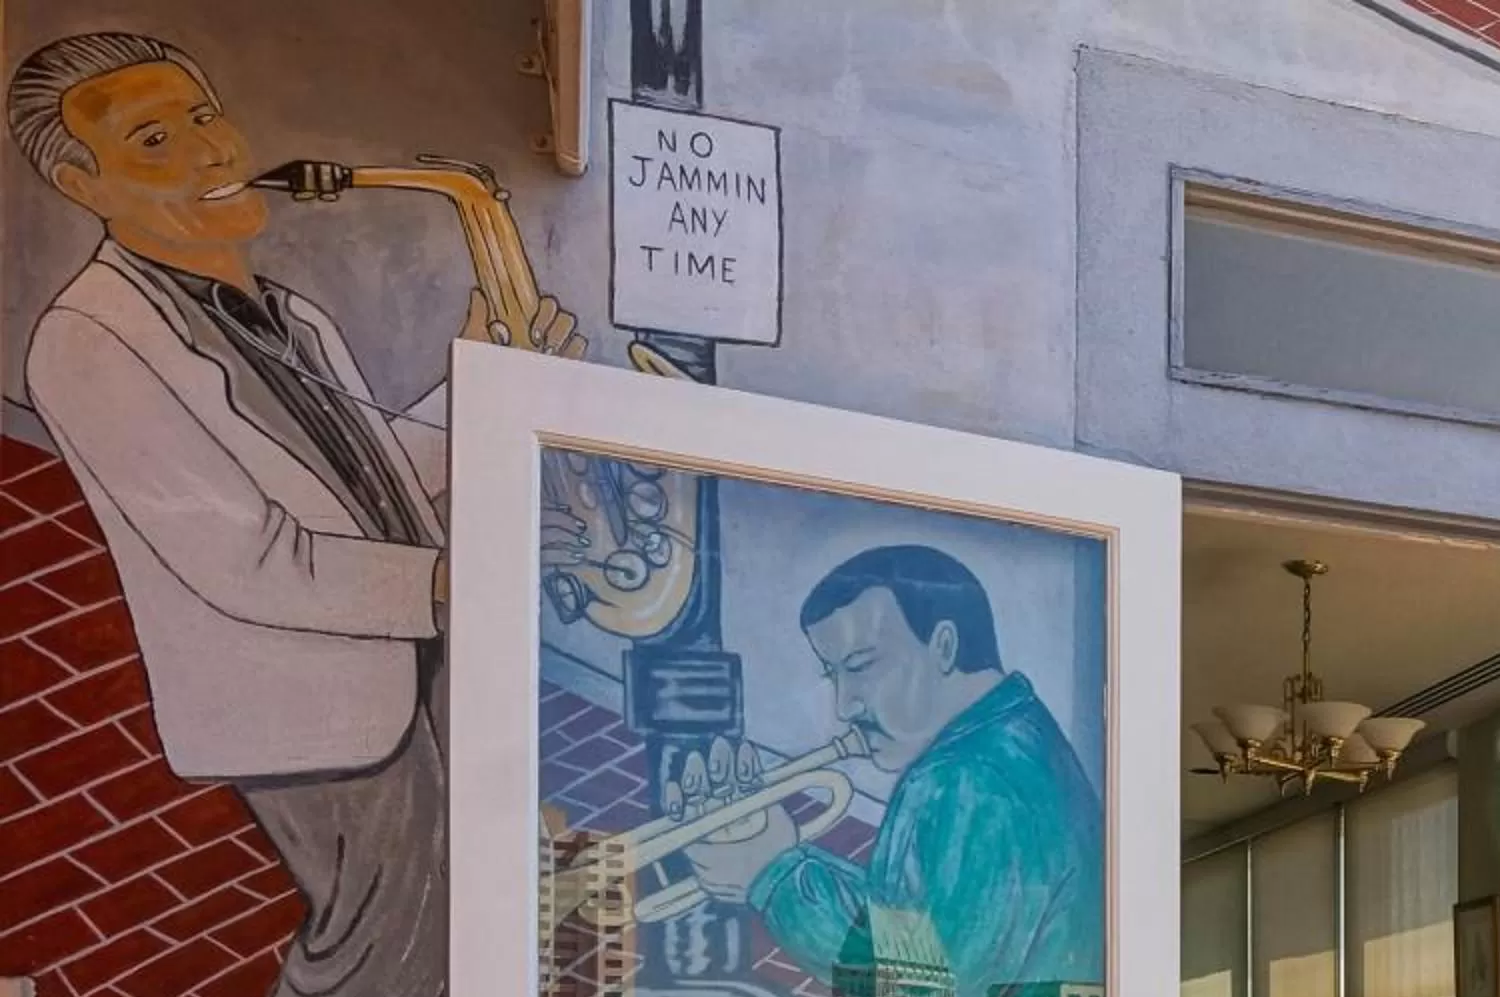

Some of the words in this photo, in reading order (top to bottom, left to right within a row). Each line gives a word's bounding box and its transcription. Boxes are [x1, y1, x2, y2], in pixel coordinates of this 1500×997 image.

[657, 129, 714, 159] NO
[628, 155, 767, 205] JAMMIN
[667, 201, 728, 238] ANY
[639, 245, 737, 284] TIME
